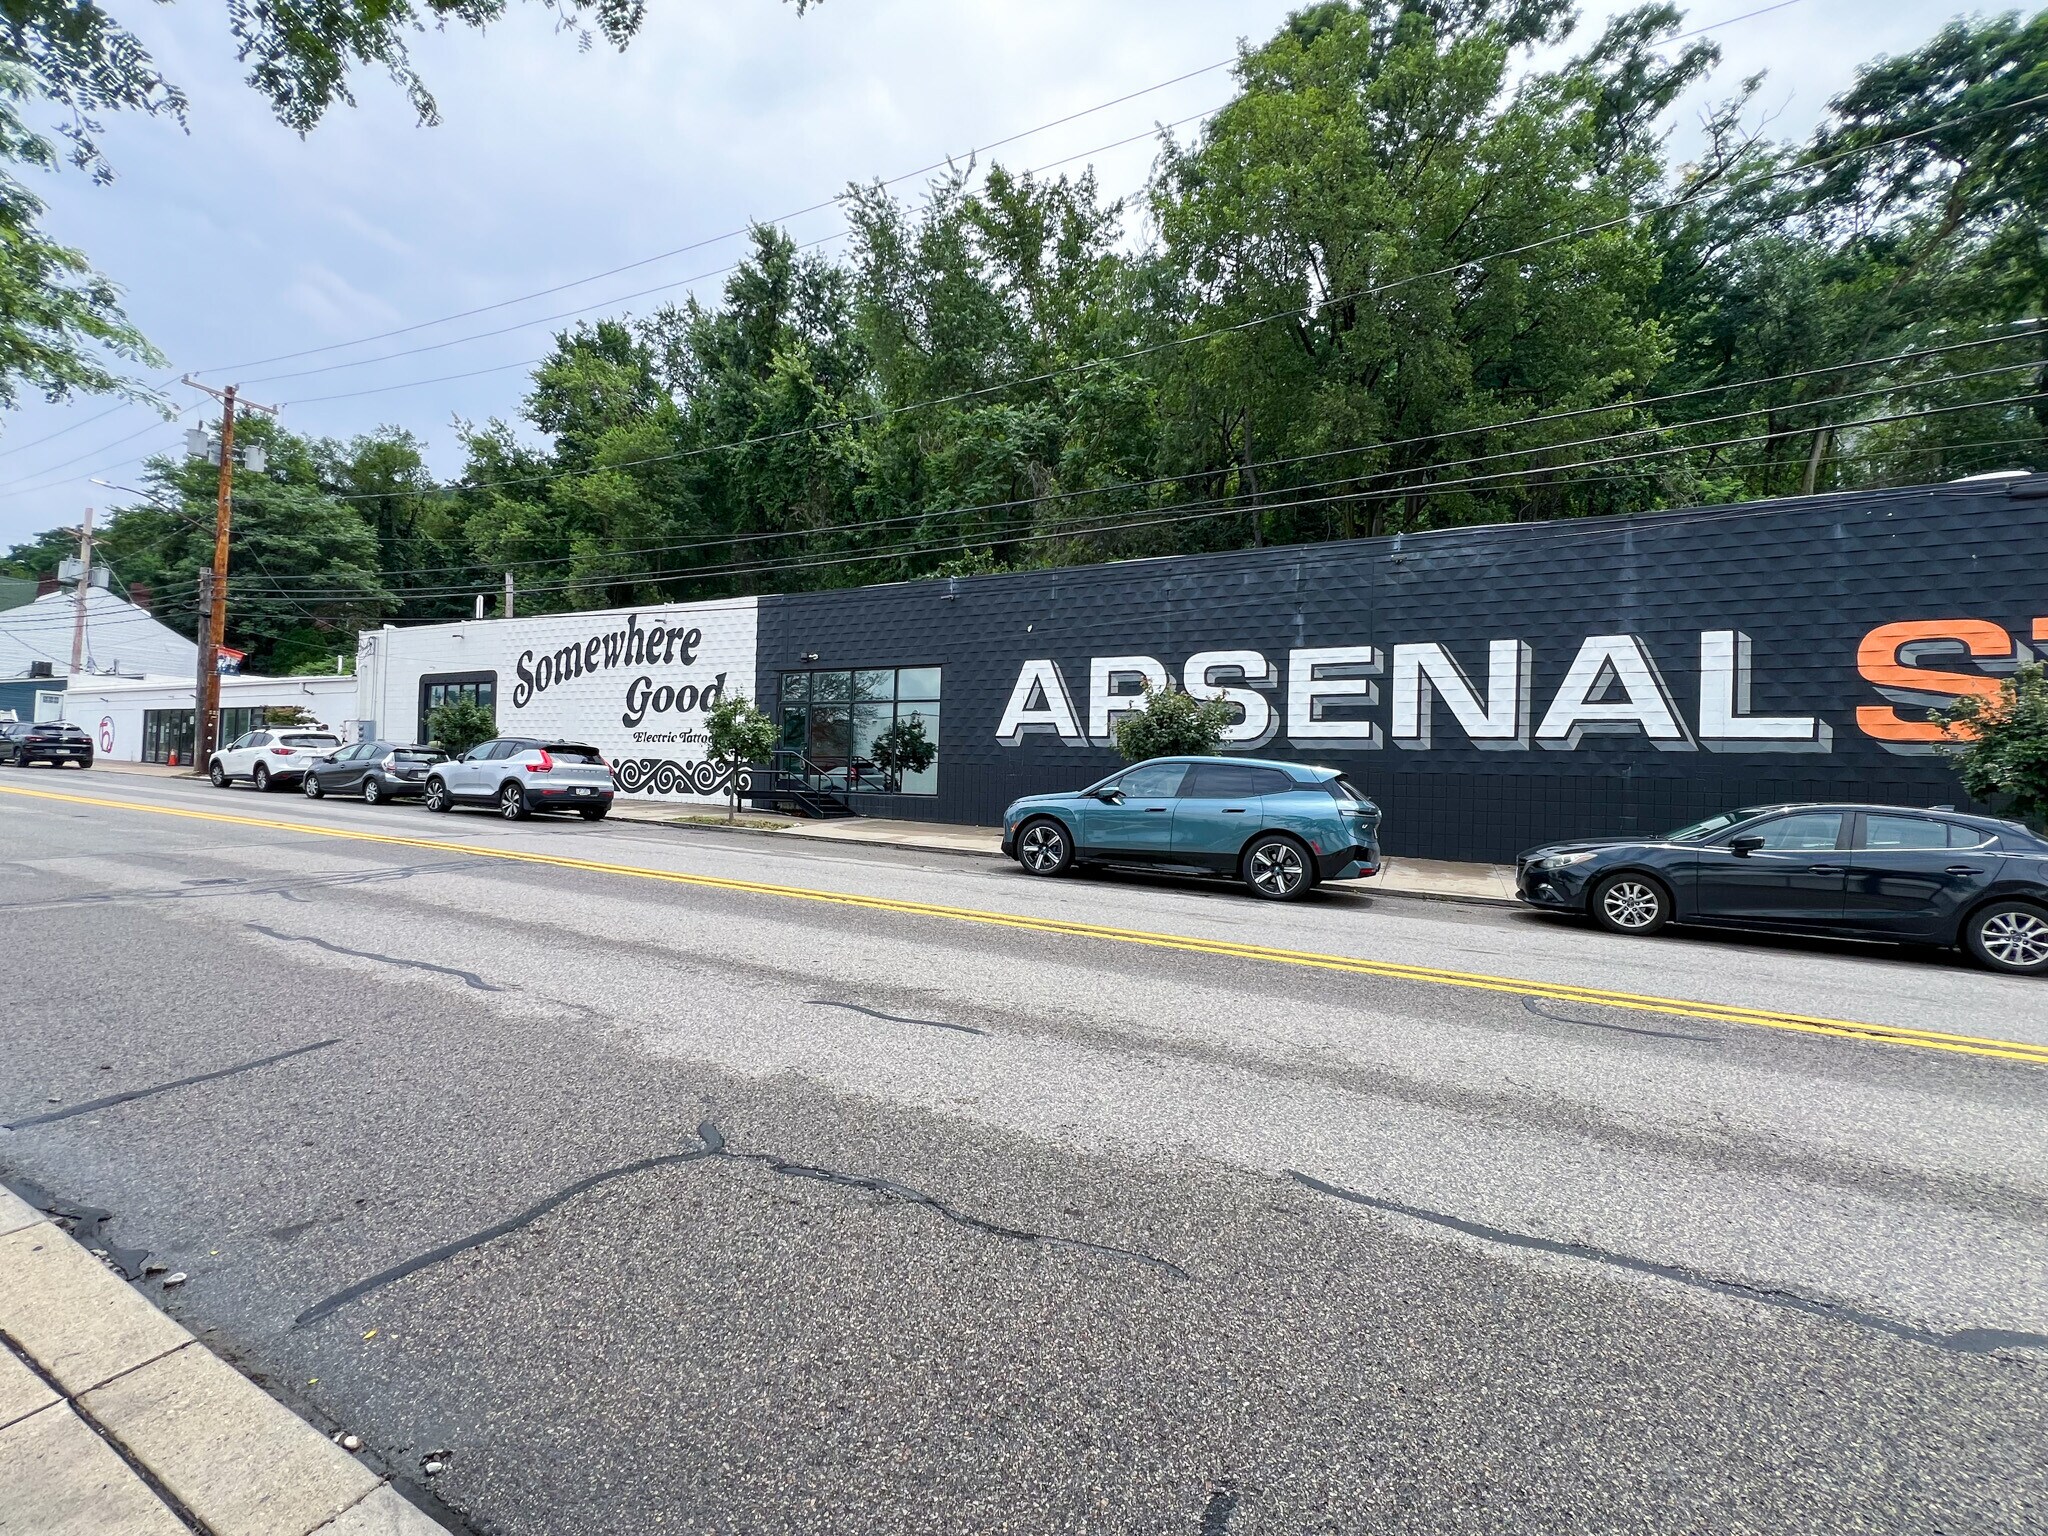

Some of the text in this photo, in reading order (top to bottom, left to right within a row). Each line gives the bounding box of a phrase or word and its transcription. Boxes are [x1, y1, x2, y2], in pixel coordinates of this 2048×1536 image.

[513, 614, 702, 709] Somewhere
[996, 617, 2048, 743] ARSENAL S
[622, 672, 727, 728] Good
[633, 731, 678, 743] Electric
